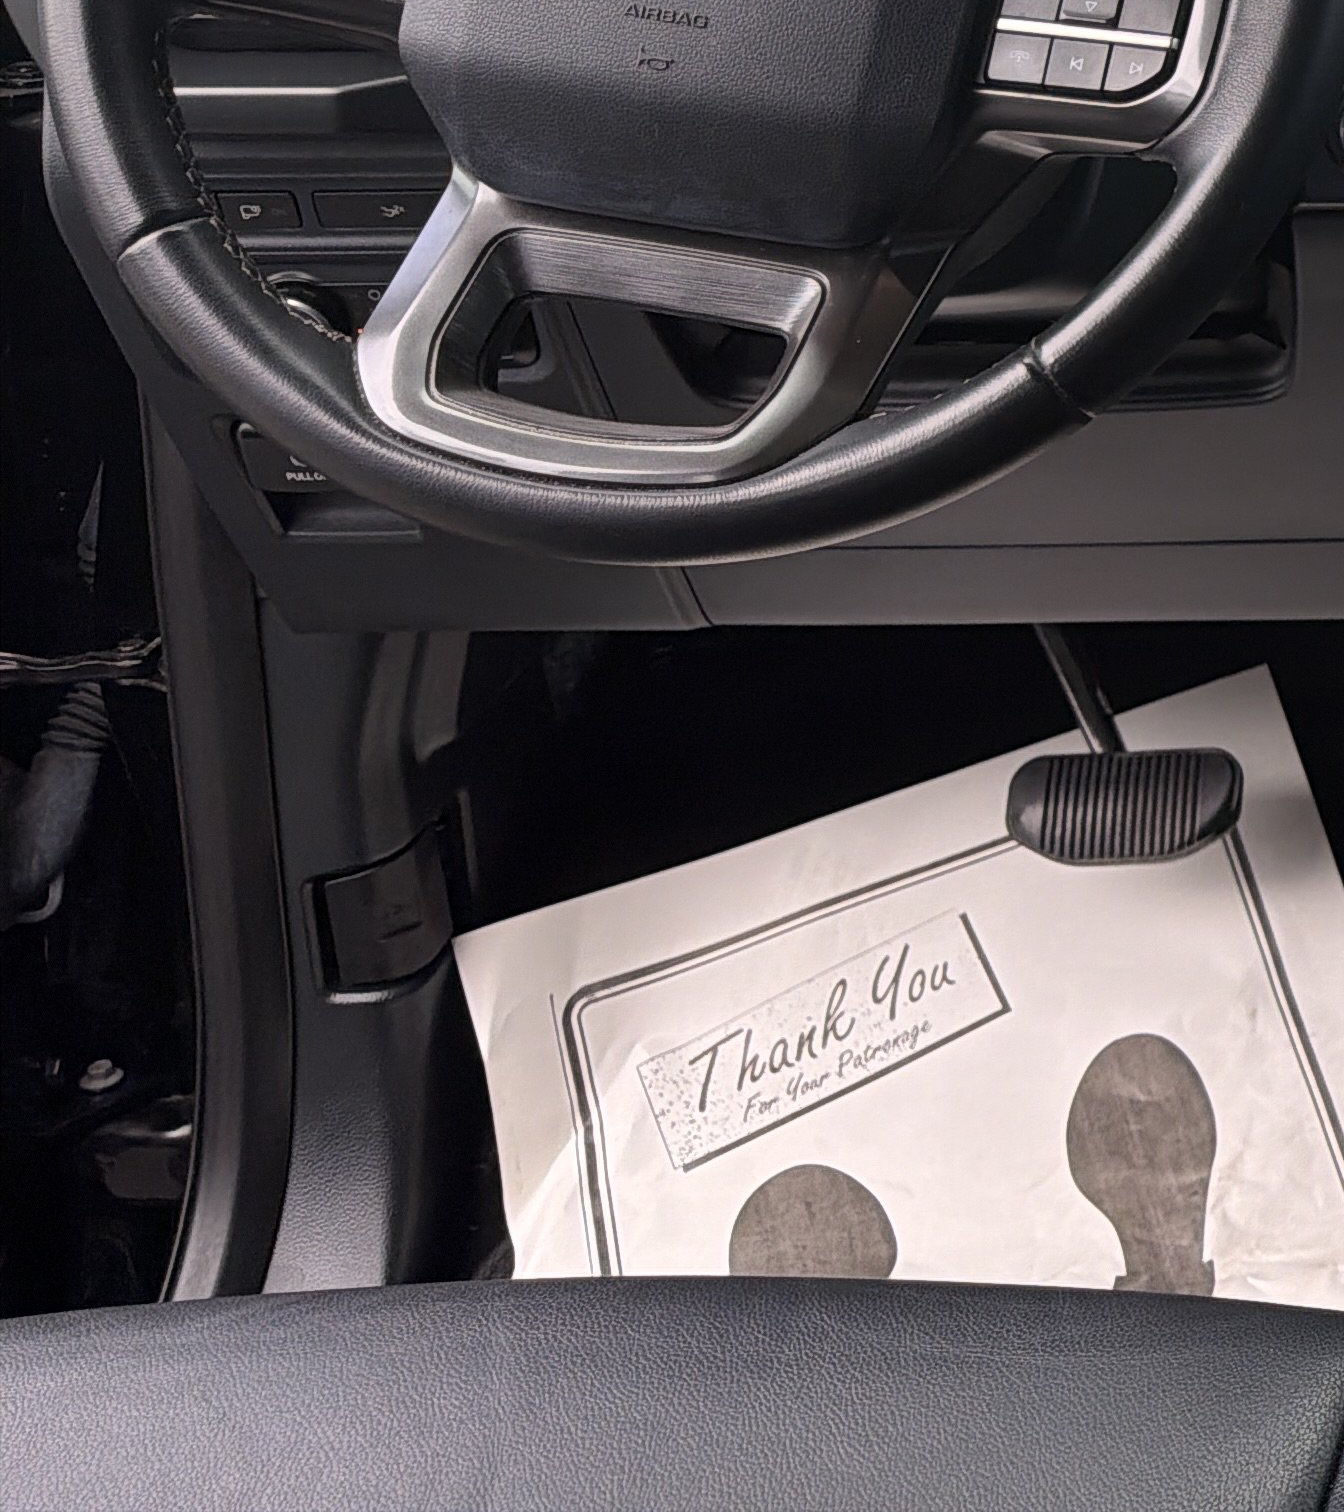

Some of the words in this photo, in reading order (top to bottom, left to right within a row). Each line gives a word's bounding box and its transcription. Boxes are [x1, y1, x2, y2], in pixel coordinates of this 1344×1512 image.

[623, 3, 710, 29] AIRBAG
[688, 977, 856, 1113] Thank
[871, 943, 957, 1020] You
[743, 1091, 780, 1123] For
[786, 1072, 830, 1101] Your
[837, 1019, 933, 1077] Patronage
